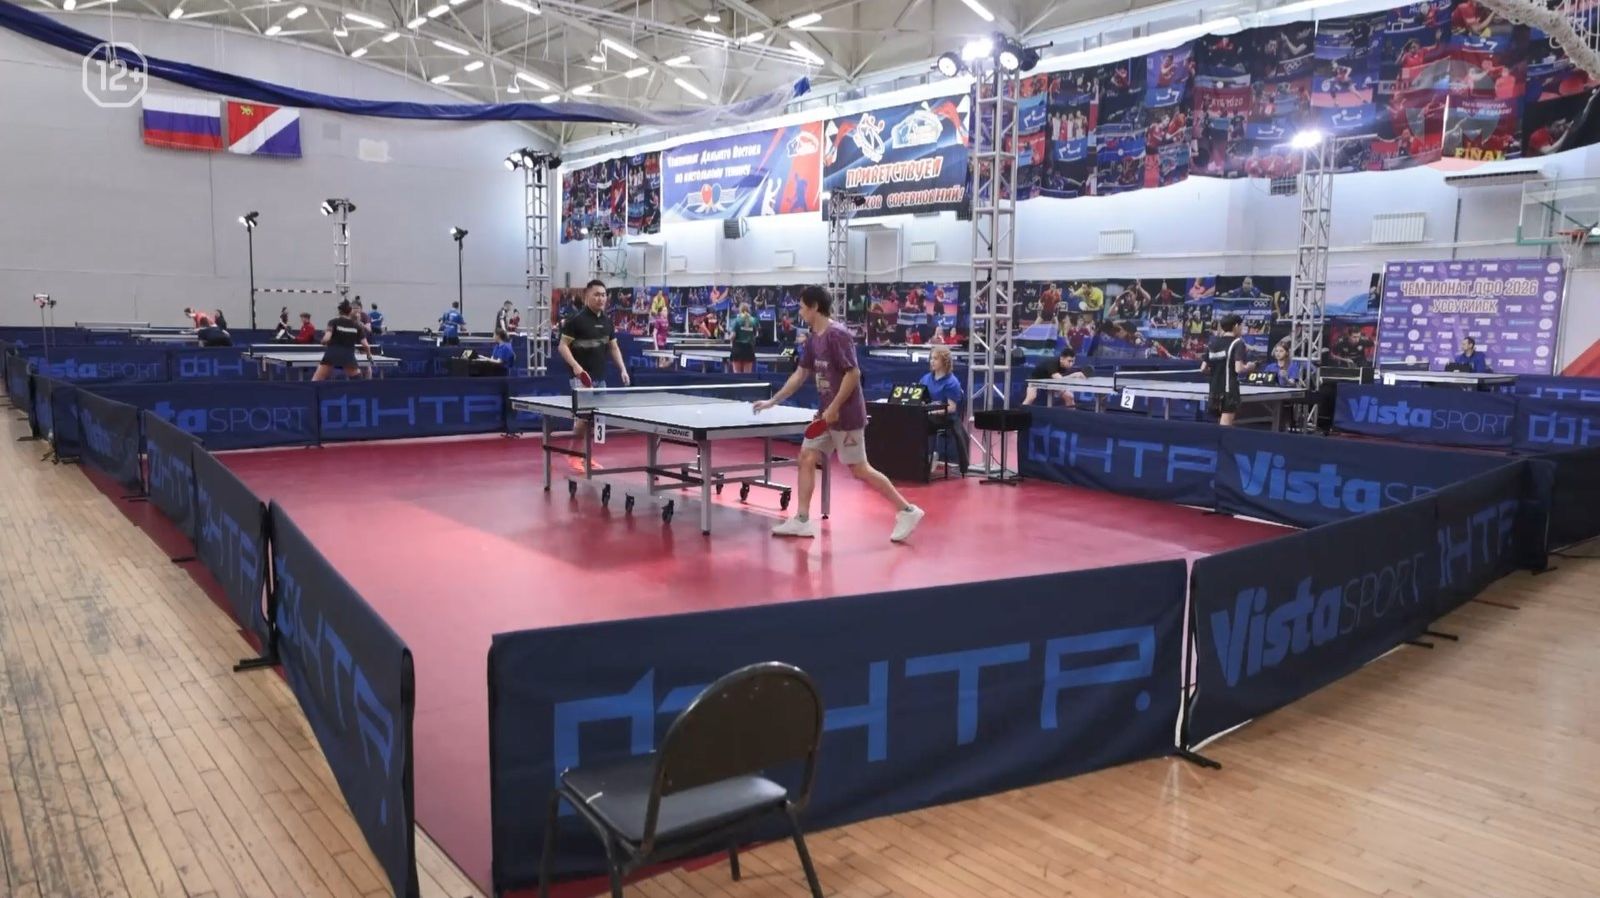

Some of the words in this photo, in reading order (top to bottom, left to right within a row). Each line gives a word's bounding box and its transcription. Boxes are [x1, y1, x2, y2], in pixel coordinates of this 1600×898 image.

[887, 185, 965, 209] СОРЕВНОВНИЙ!
[1401, 279, 1472, 297] ЧЕМПИОНАТ
[1471, 279, 1503, 298] ДФО
[1503, 278, 1539, 296] 2026
[1433, 299, 1499, 314] УССУРИЙСК
[893, 386, 903, 398] 3
[912, 388, 922, 399] 2
[1124, 395, 1131, 406] 2
[597, 425, 603, 441] 3
